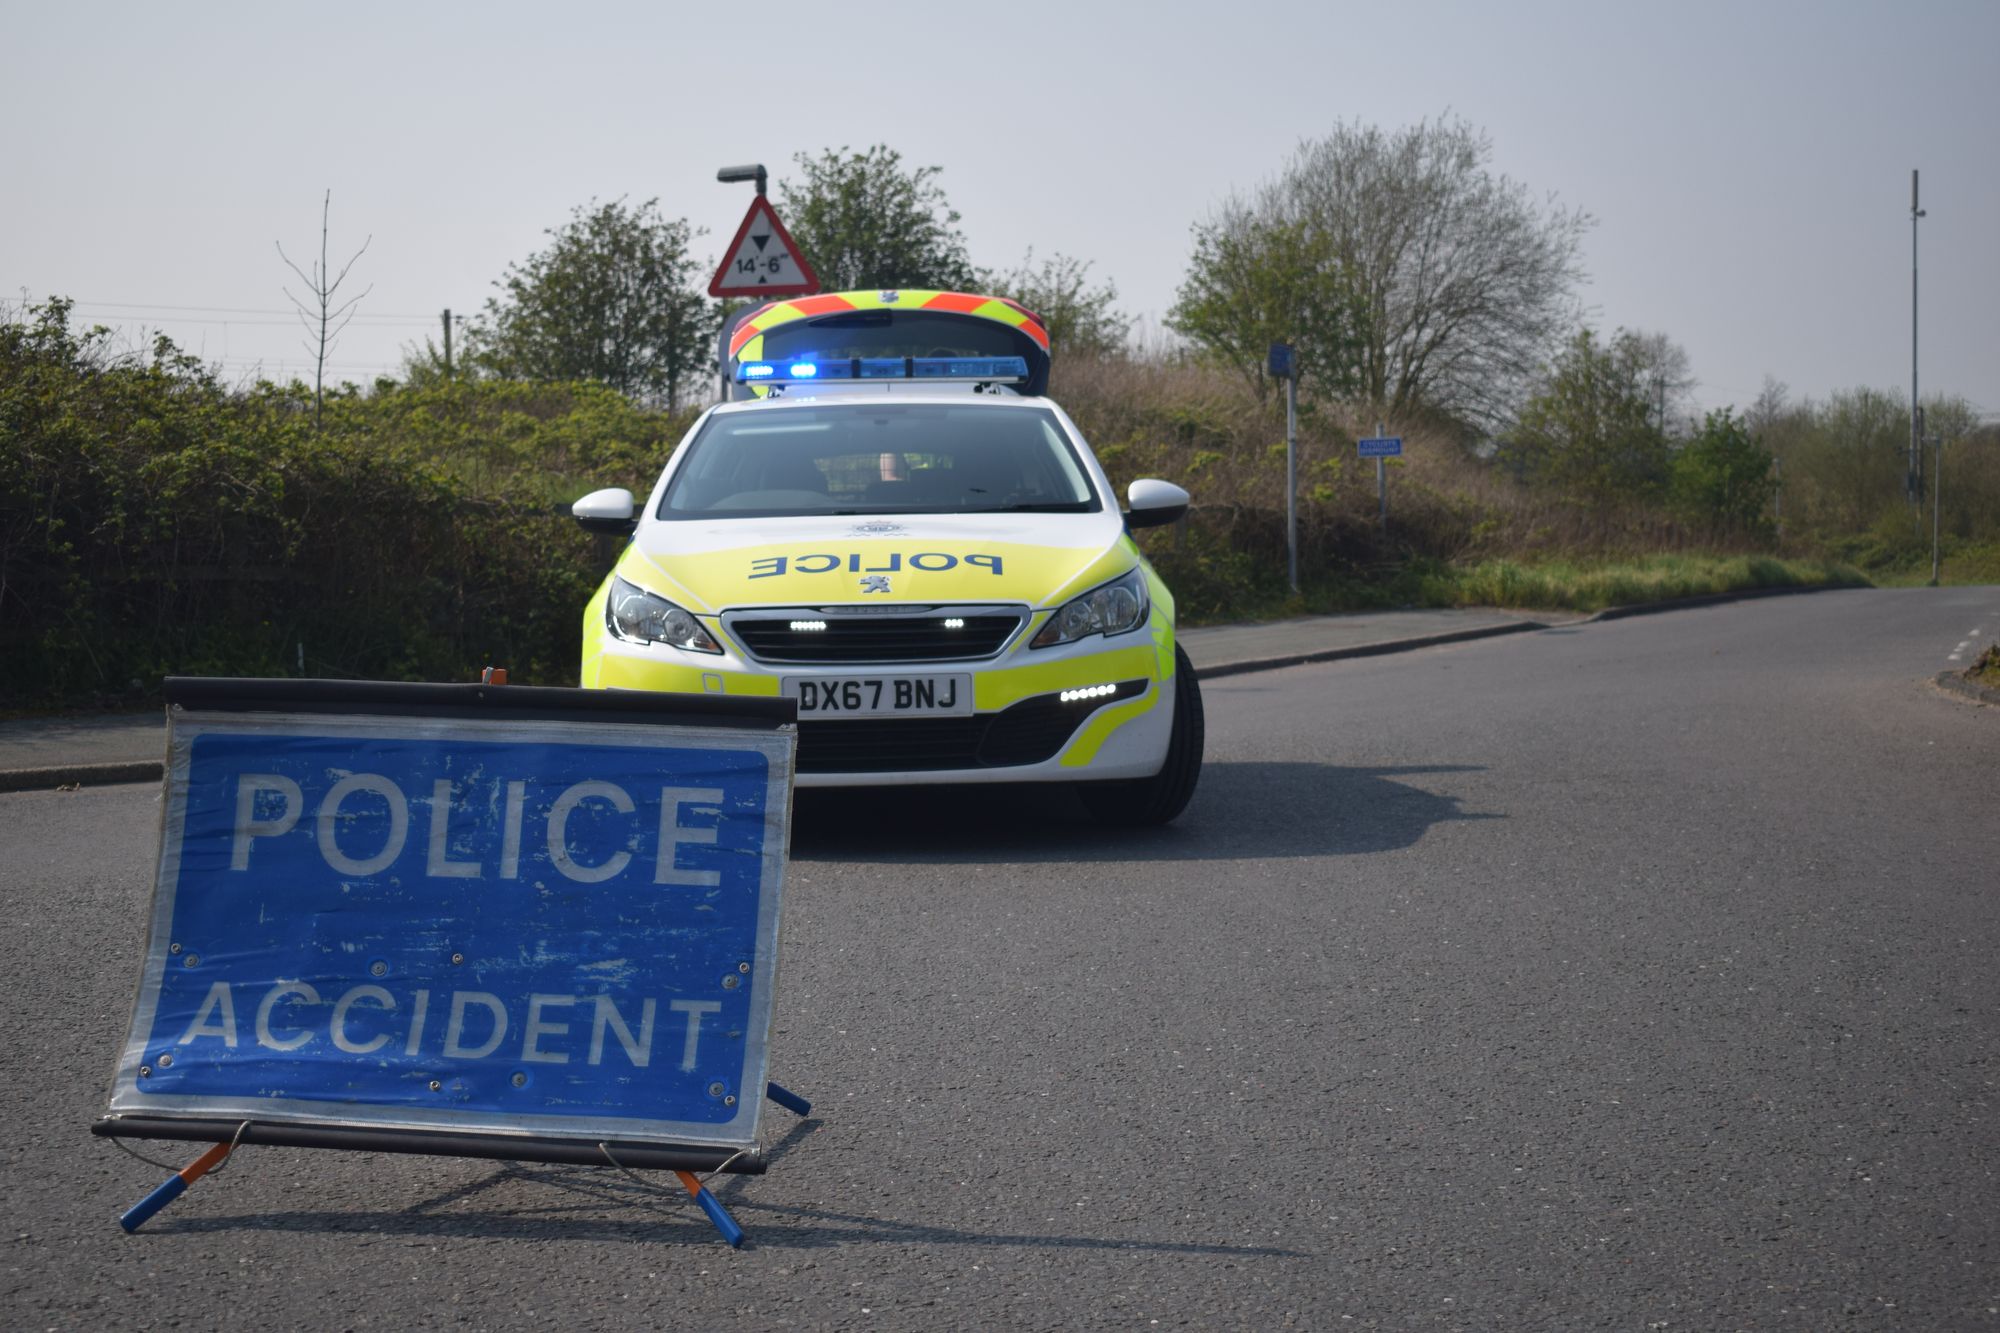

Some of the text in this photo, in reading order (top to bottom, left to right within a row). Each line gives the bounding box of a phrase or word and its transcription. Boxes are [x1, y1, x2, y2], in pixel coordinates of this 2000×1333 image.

[799, 679, 956, 711] DX67 BNJ
[229, 772, 724, 887] POLICE
[177, 979, 722, 1072] ACCIDENT
